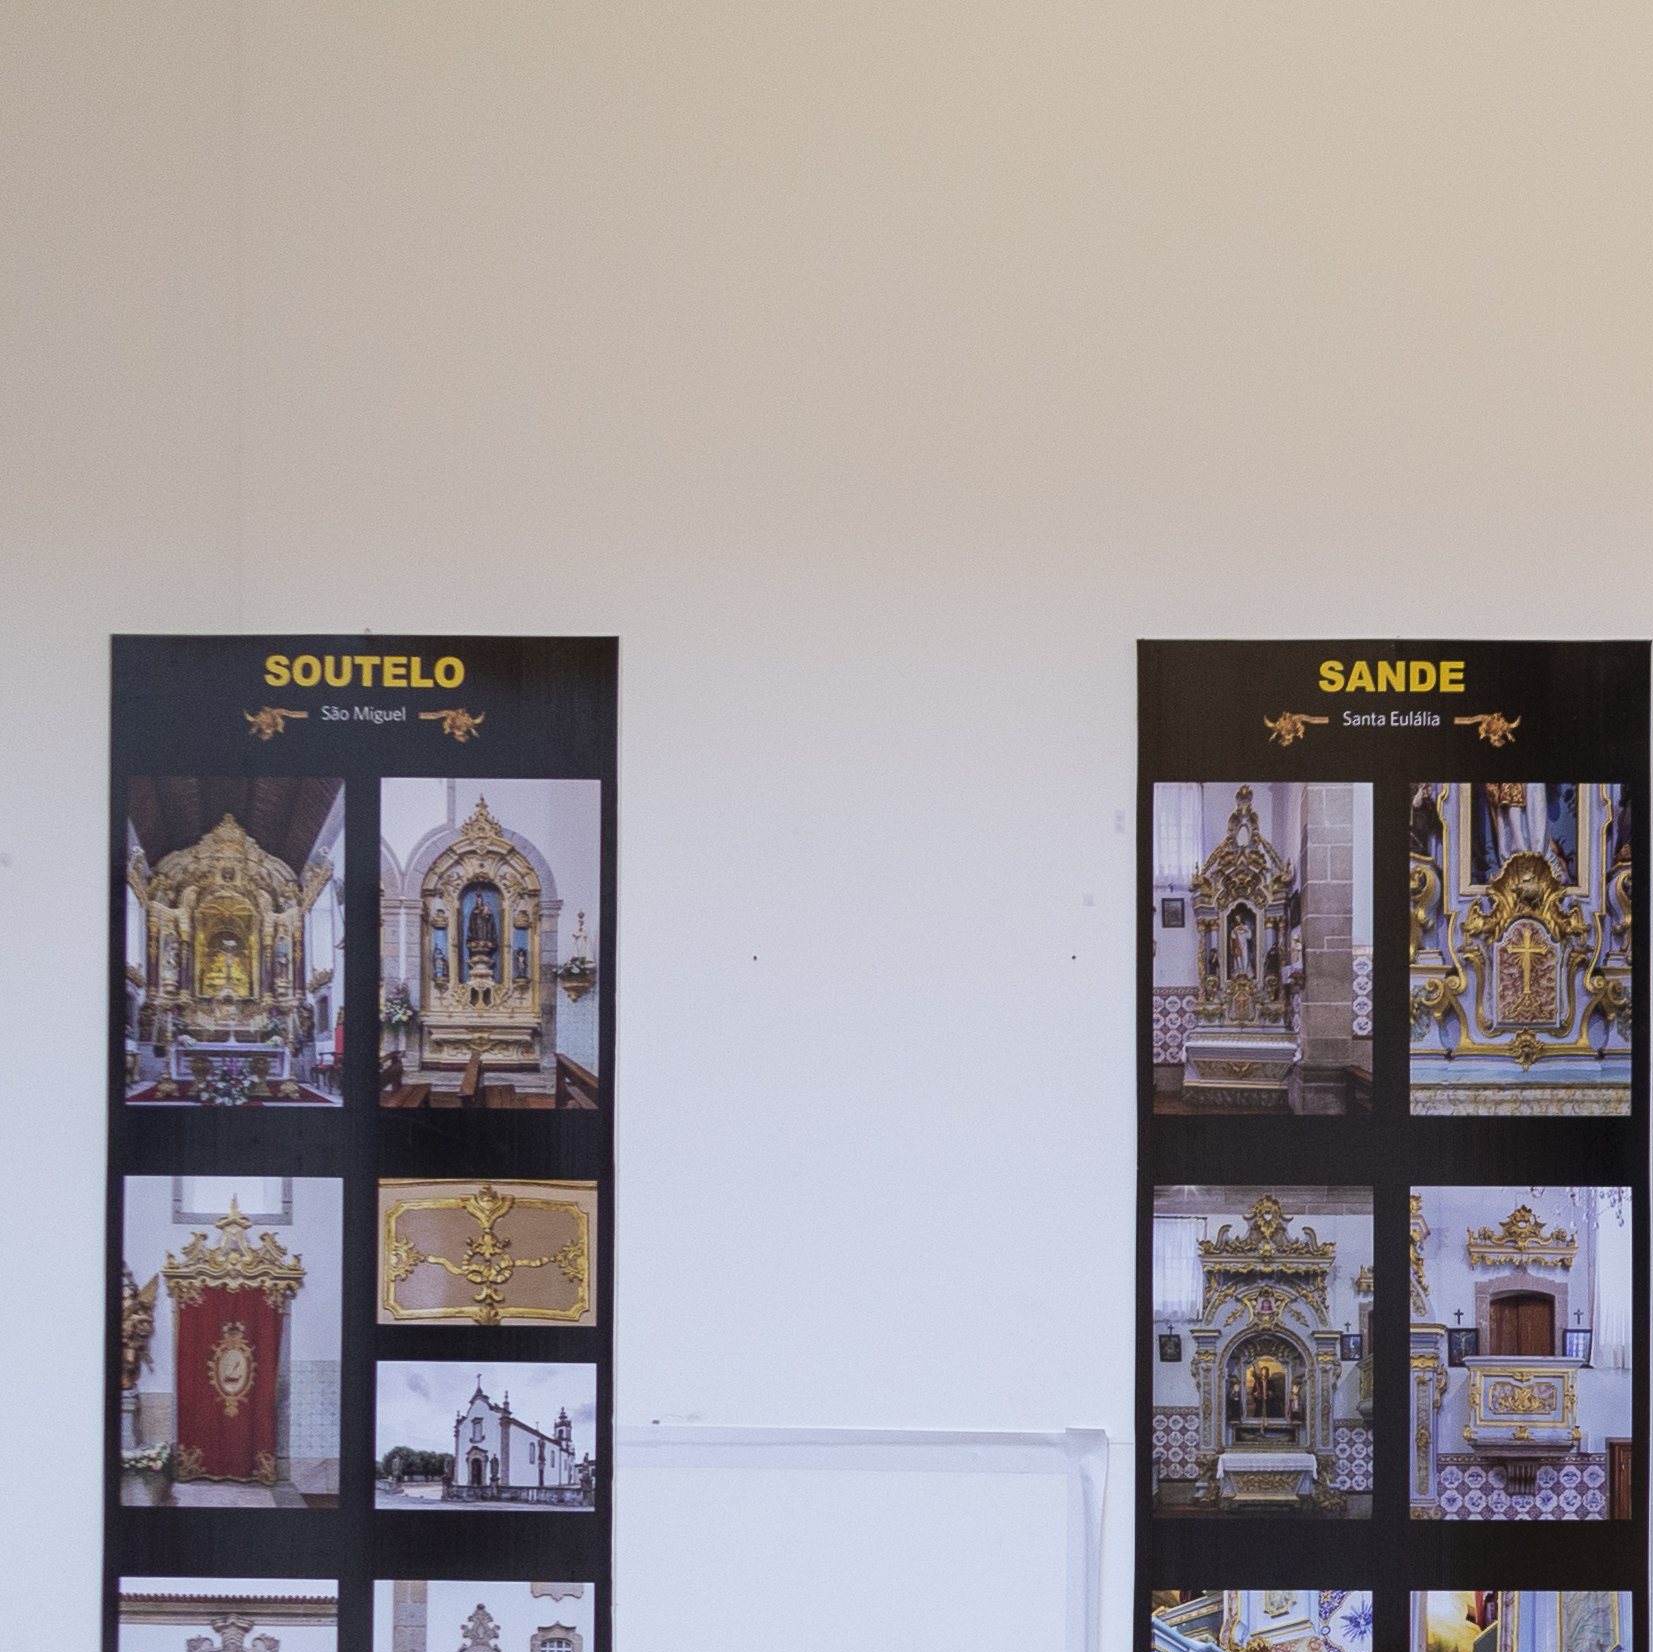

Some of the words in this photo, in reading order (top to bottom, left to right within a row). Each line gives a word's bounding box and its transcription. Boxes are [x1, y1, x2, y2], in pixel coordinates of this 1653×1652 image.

[265, 654, 464, 689] SOUTELO
[1317, 659, 1466, 694] SANDE
[321, 705, 350, 721] São
[353, 704, 406, 725] Miguel
[1342, 710, 1386, 727] Santa
[1390, 710, 1441, 727] Eulália
